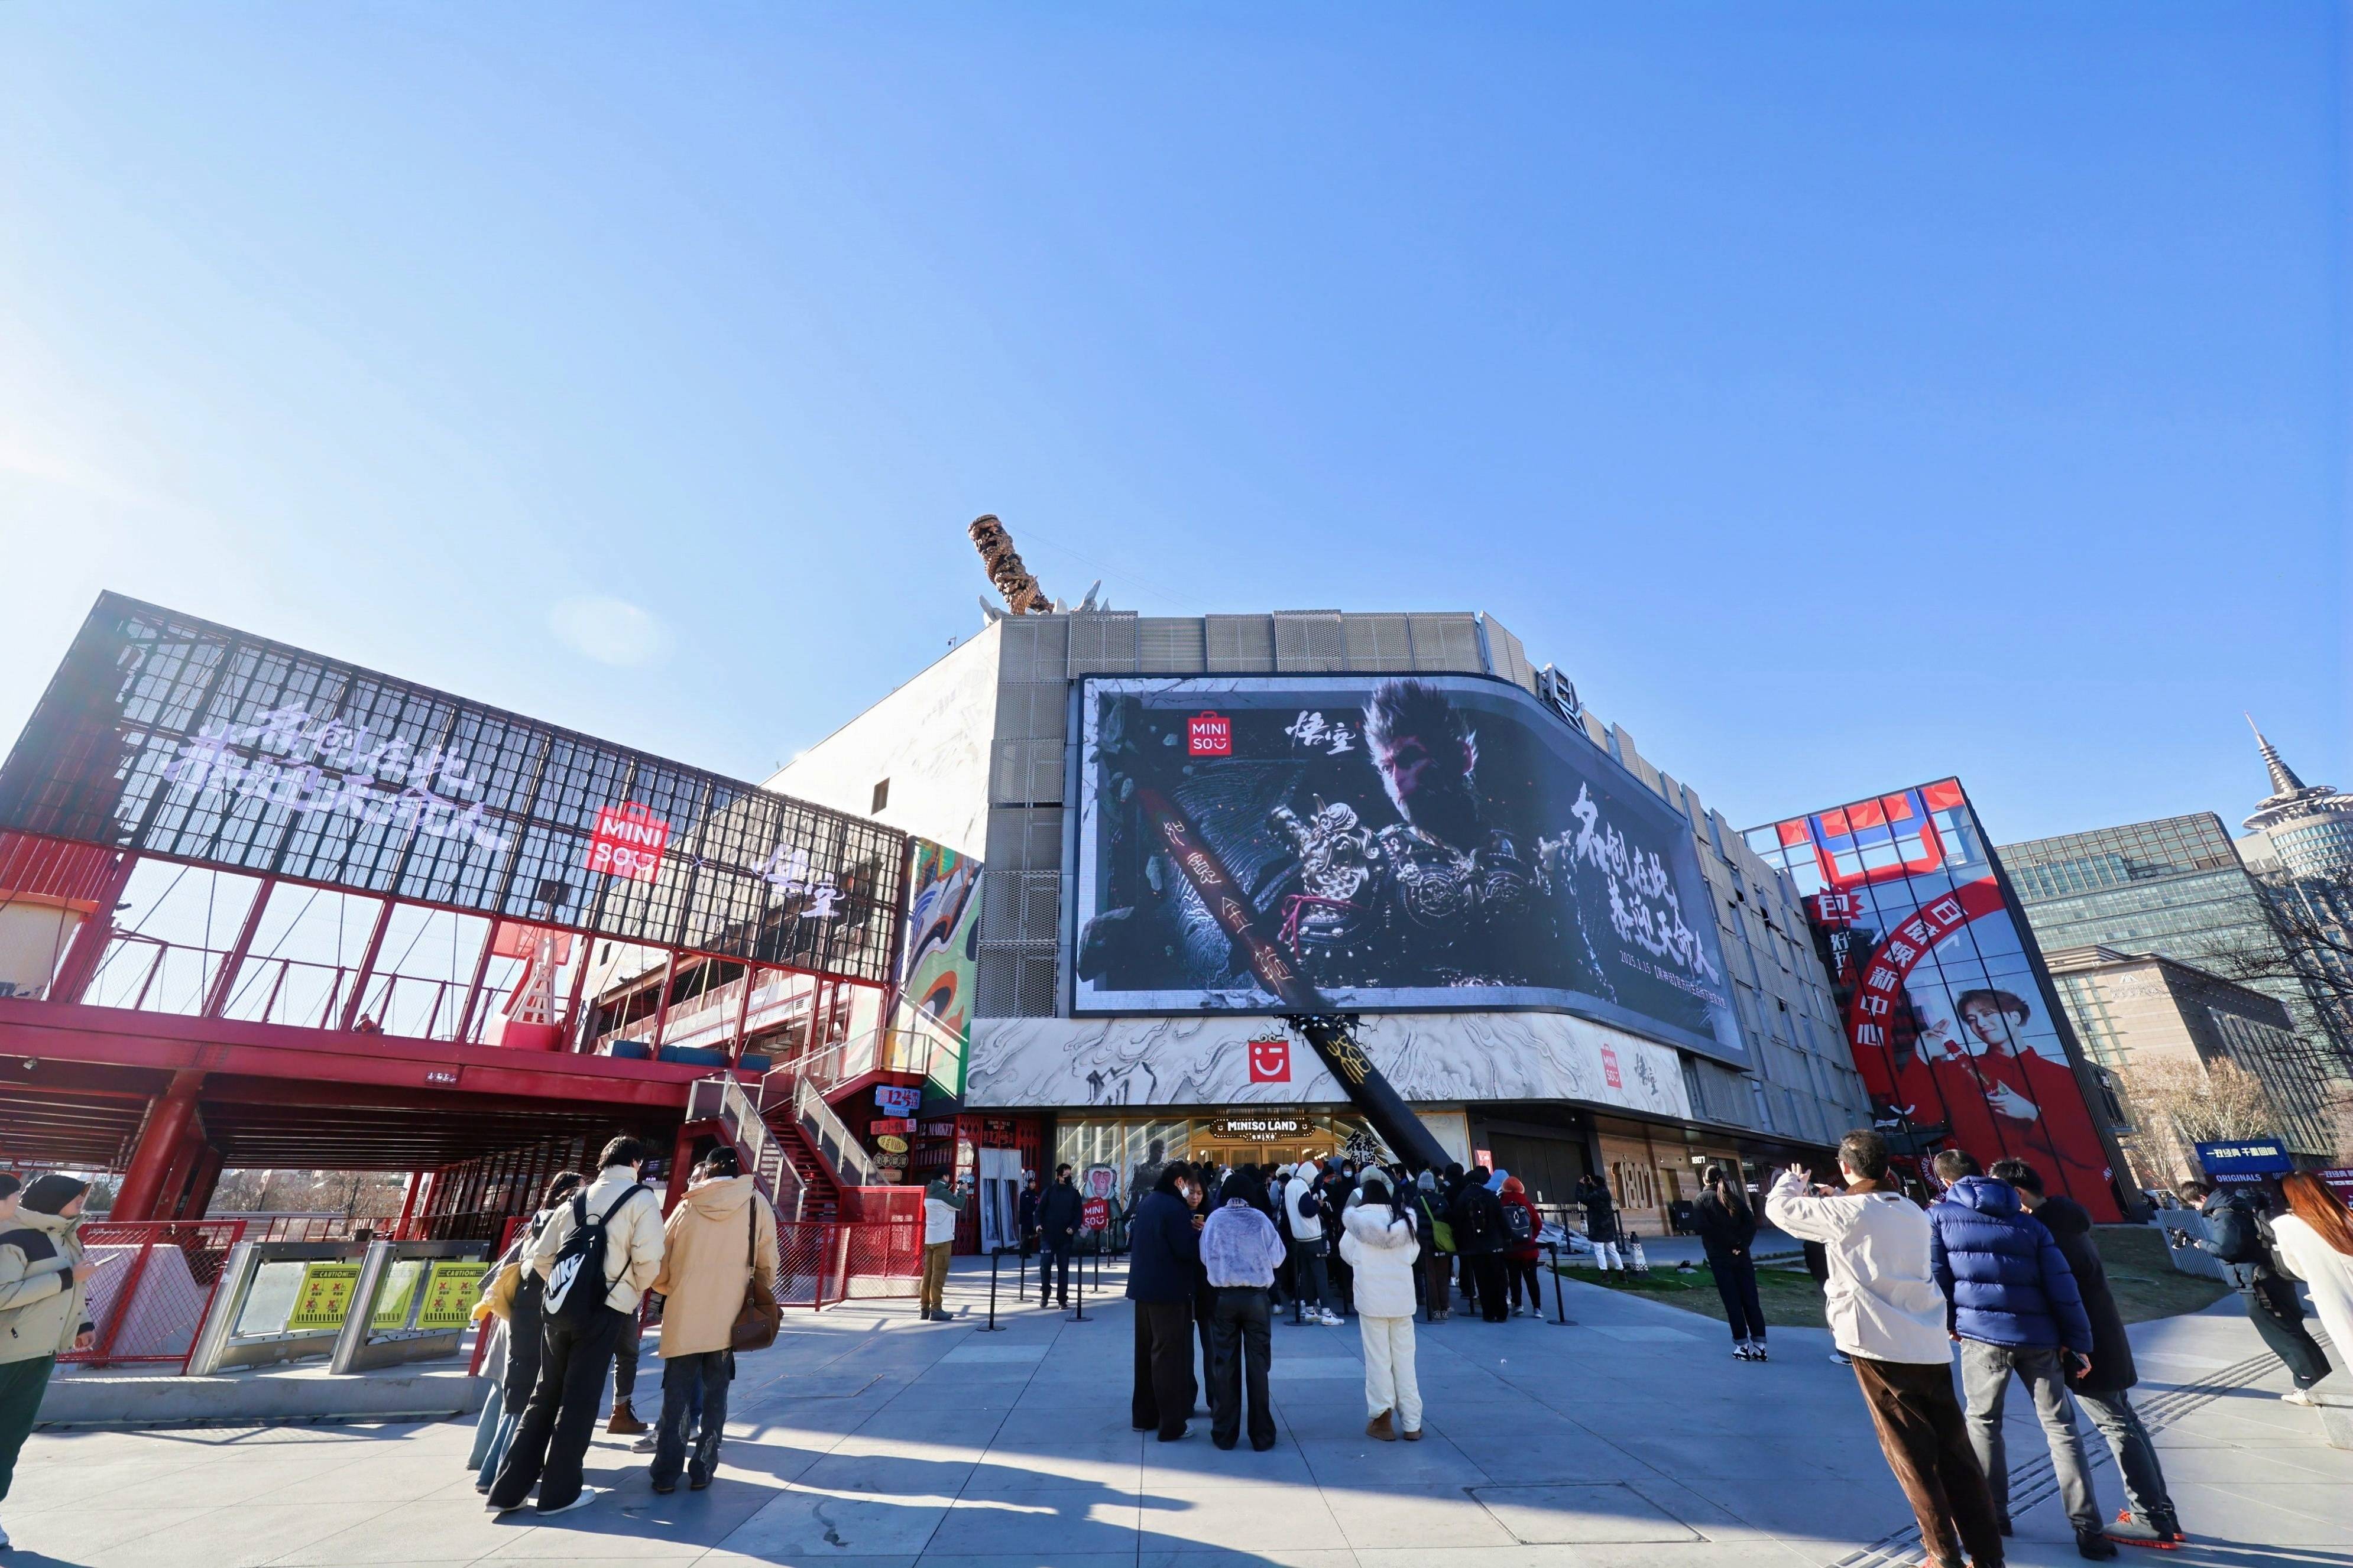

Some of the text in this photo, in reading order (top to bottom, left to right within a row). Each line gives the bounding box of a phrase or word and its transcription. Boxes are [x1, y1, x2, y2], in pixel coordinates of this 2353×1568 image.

[1192, 723, 1226, 735] MINI
[1285, 710, 1356, 755] 悟空
[601, 817, 662, 848] MINI
[1571, 781, 1679, 911] 名创在此
[1818, 894, 1851, 920] 包
[1619, 950, 1651, 975] 2025.1.15
[1603, 1054, 1616, 1069] MINI
[928, 1123, 955, 1137] MARKET
[1227, 1121, 1297, 1131] MINISO LAND
[1691, 1155, 1706, 1164] 1807
[1618, 1161, 1654, 1209] 1807
[2216, 1174, 2262, 1183] ORIGINALS
[1085, 1205, 1104, 1216] MINI
[547, 1253, 580, 1297] NIKE
